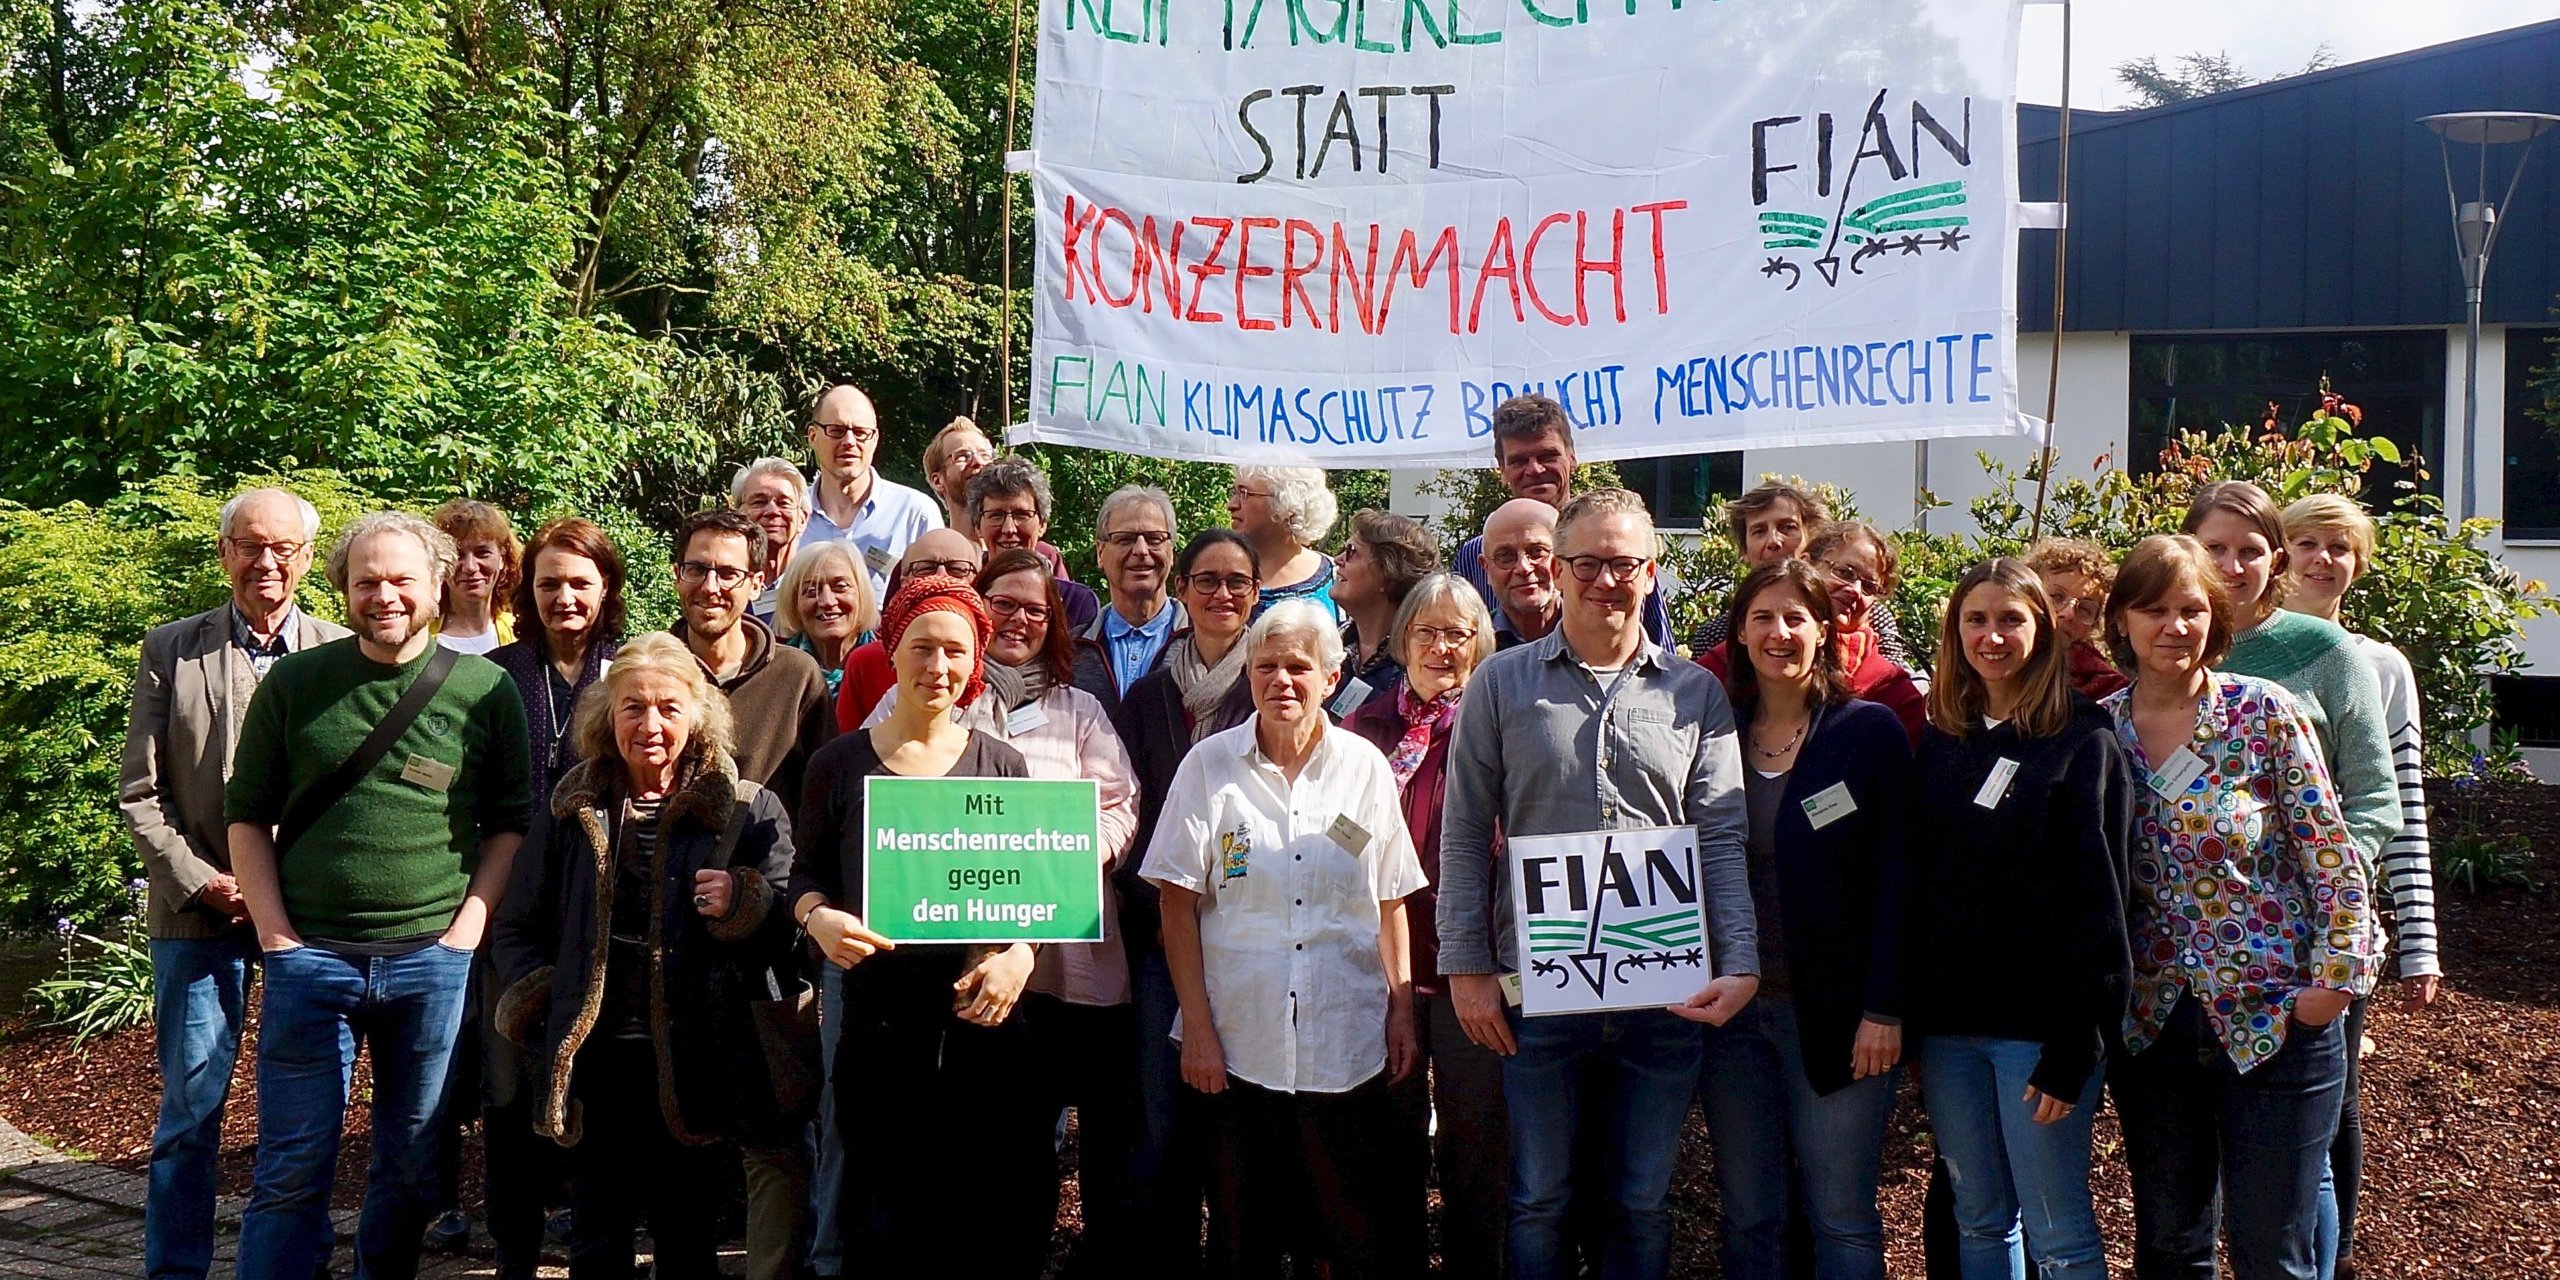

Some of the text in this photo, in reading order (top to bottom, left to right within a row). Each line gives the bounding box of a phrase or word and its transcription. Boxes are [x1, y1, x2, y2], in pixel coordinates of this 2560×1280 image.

[1237, 84, 1456, 183] STATT
[1752, 88, 1971, 206] FIAN
[1064, 195, 1688, 335] KONZERNMACHT
[1050, 355, 1166, 428] FIAN
[1183, 379, 1436, 445] KLIMASCHUTZ
[1655, 333, 1994, 425] MENSCHENRECHTE
[876, 827, 1091, 851] Menschenrechten
[965, 794, 1005, 815] Mit
[912, 897, 1057, 927] den Hunger
[948, 868, 1021, 890] gegen
[1522, 836, 1698, 914] FIAN
